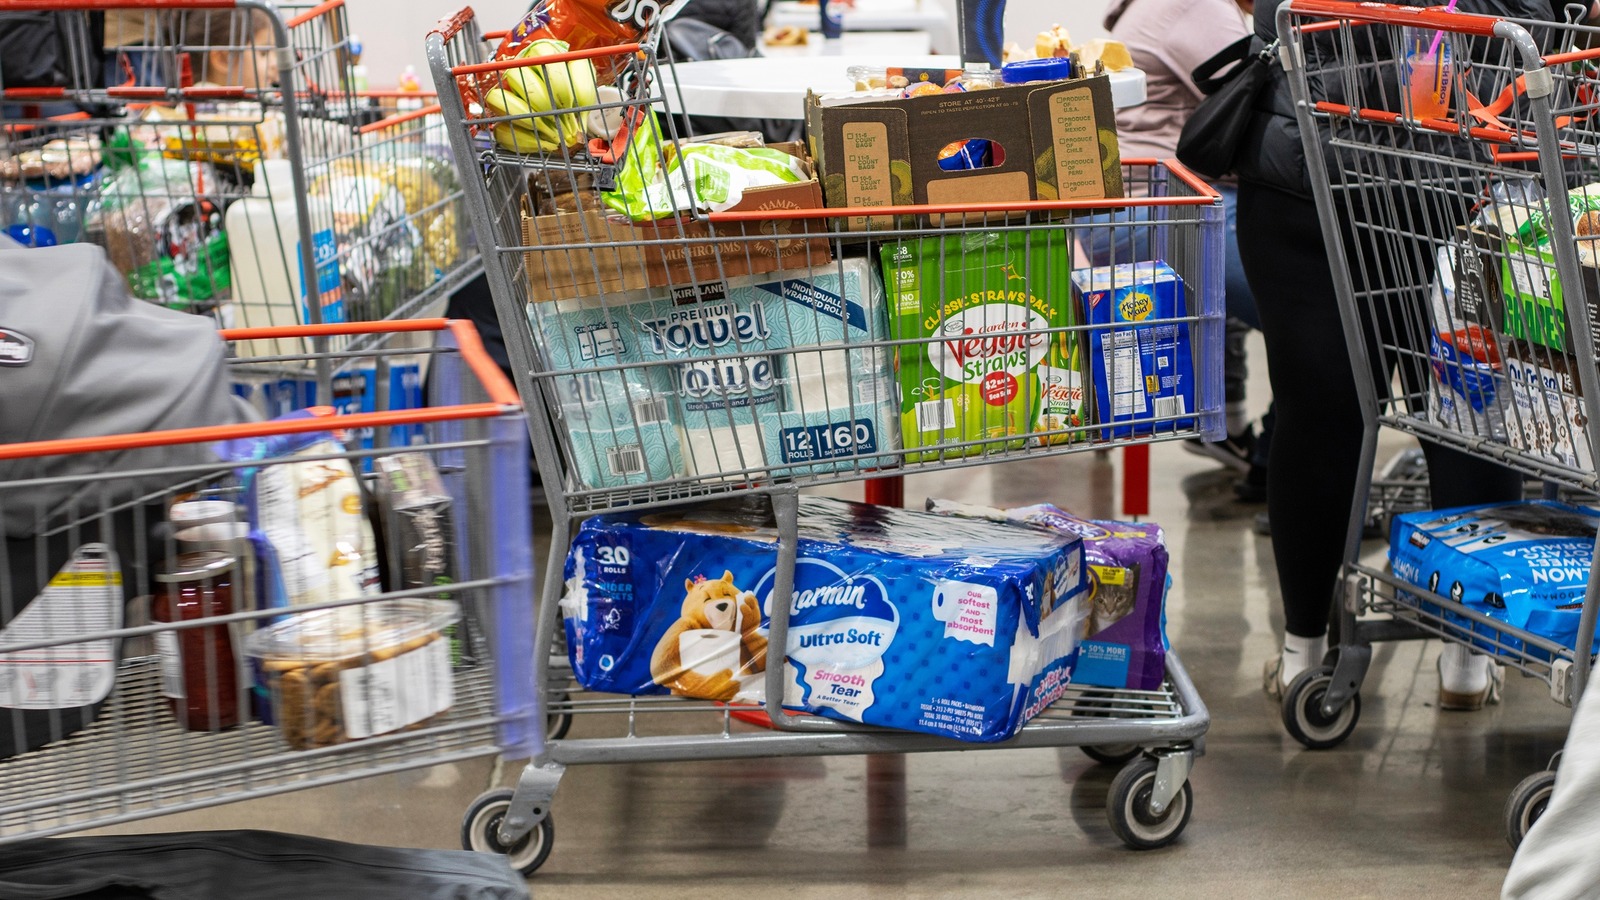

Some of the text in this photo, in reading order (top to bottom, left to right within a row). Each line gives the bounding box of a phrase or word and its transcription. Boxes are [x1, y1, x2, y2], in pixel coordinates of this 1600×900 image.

[939, 100, 962, 108] STORE
[756, 199, 801, 212] HAMP'S
[663, 241, 741, 261] MUSHROOMS
[753, 235, 808, 258] MUSROOMS
[674, 283, 725, 299] KIRLAND
[901, 293, 914, 302] NO
[924, 295, 970, 331] CLASSIC
[970, 289, 1027, 304] STRAWS
[1121, 297, 1149, 311] Honey
[1127, 305, 1148, 318] Maid
[963, 350, 1027, 381] Straws
[985, 378, 997, 390] 42
[1000, 388, 1012, 397] Slt
[786, 431, 813, 451] 12
[821, 423, 870, 449] 160
[788, 450, 815, 459] ROLLS
[824, 448, 846, 456] SHETS
[597, 545, 630, 566] 30
[1502, 543, 1593, 557] ORMULA
[1523, 549, 1593, 560] OTATO
[1528, 557, 1593, 568] SWEET
[603, 566, 626, 574] ROLLS
[1532, 567, 1591, 584] LMON
[967, 590, 982, 598] OUR
[957, 598, 990, 609] softest
[965, 608, 981, 616] AND
[960, 616, 983, 626] most
[947, 620, 994, 636] absorbent
[800, 628, 882, 649] Ultra Soft
[1088, 644, 1126, 656] 50% MORE
[813, 669, 866, 688] Smooth
[830, 683, 862, 698] Tear
[822, 695, 842, 703] Better
